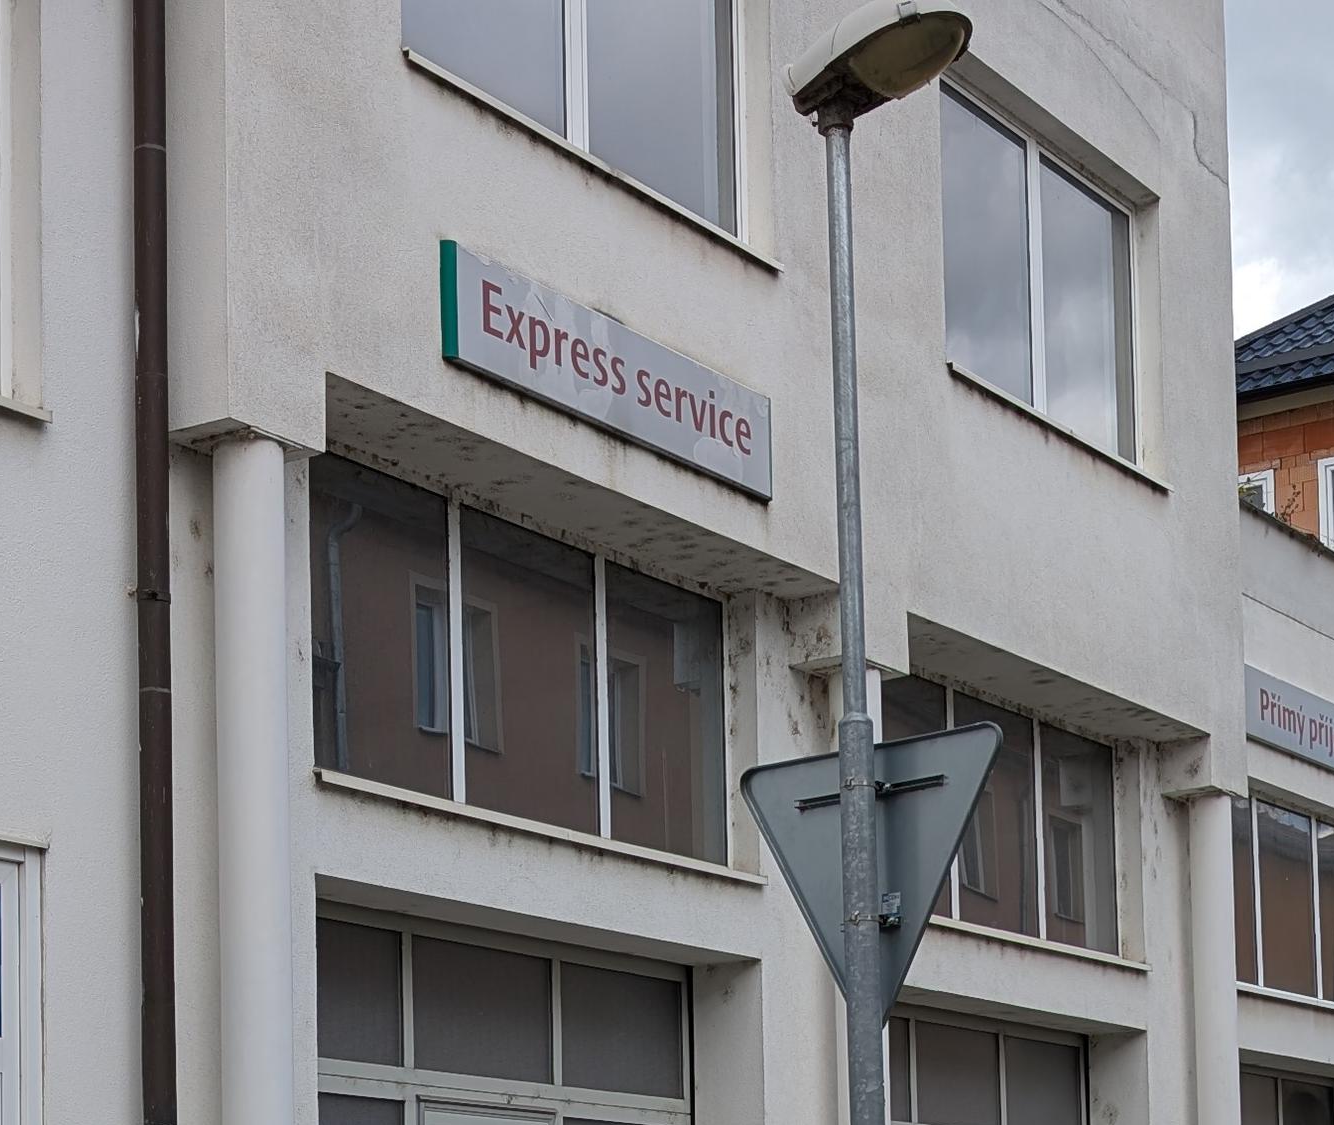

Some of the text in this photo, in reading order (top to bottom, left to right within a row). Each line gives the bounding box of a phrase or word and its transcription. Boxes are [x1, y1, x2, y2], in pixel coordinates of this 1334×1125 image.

[481, 279, 752, 456] Express service
[1259, 688, 1306, 745] Přímý
